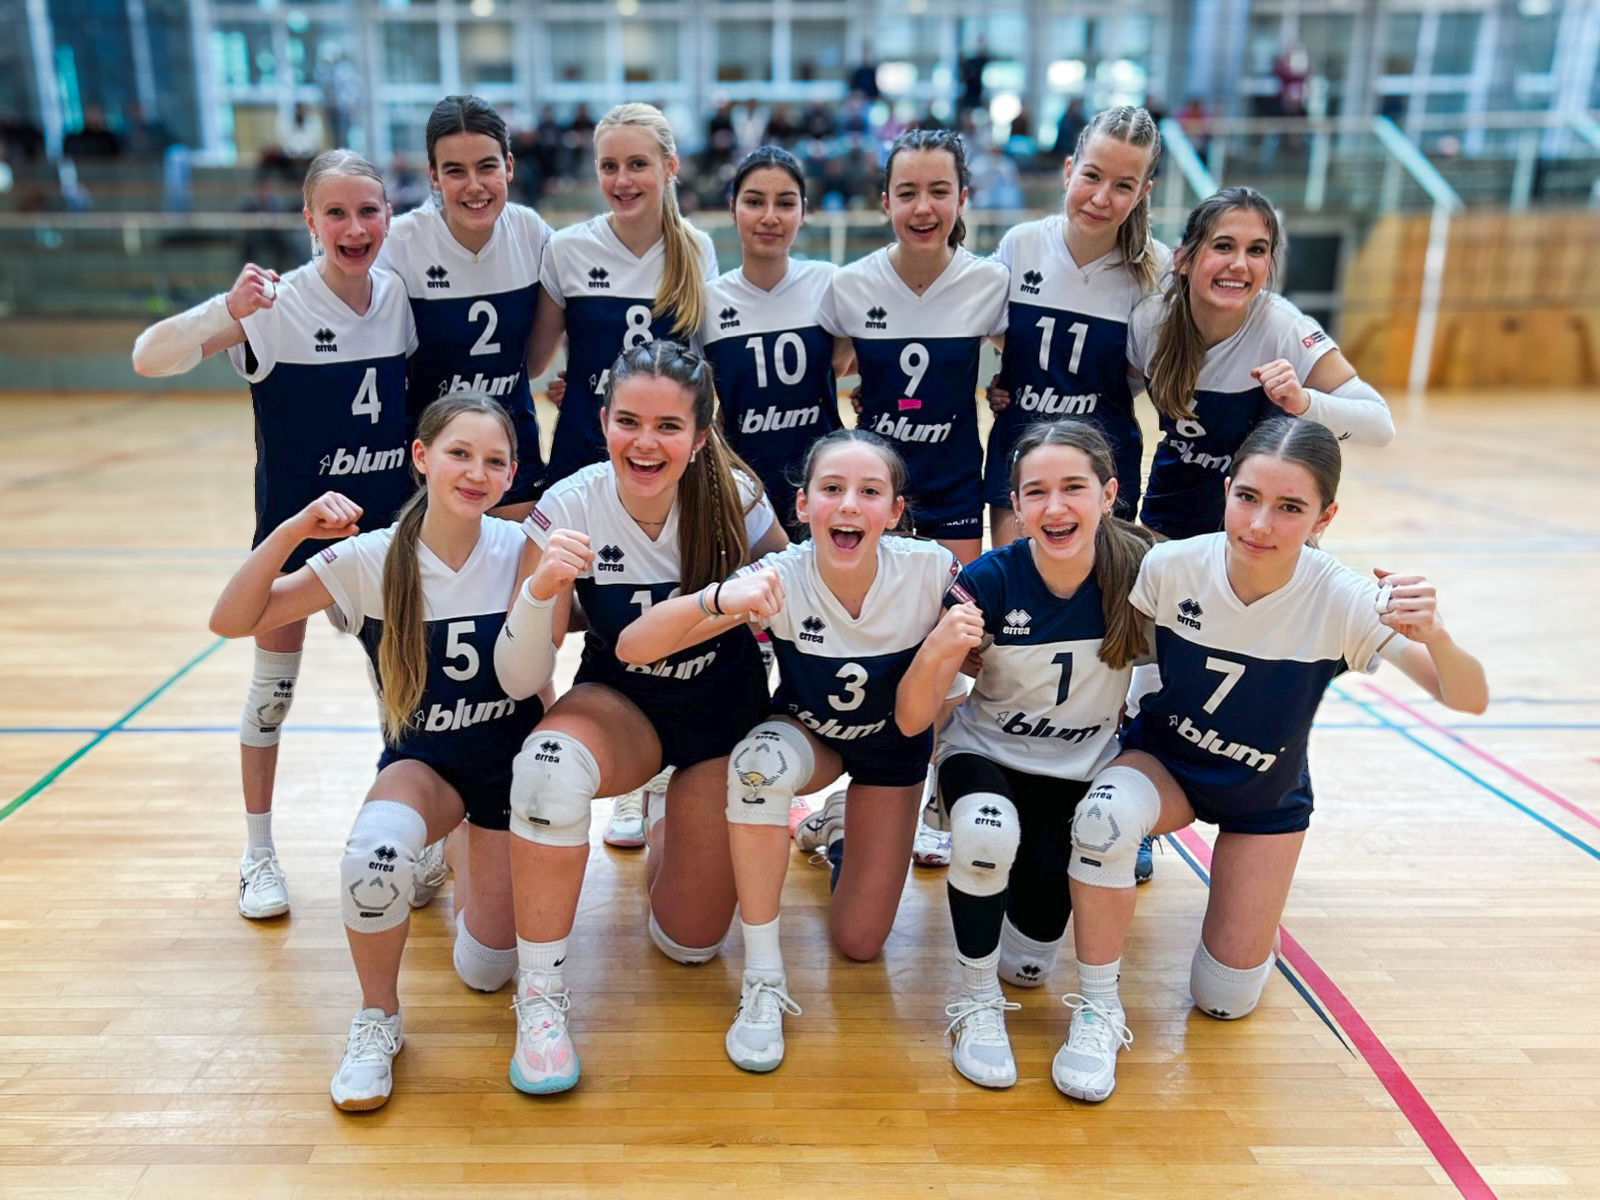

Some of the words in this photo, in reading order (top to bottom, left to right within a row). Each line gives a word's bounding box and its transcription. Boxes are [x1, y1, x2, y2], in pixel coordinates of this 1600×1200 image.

[468, 300, 501, 356] 2
[622, 305, 653, 350] 8
[1035, 316, 1089, 375] 11
[448, 371, 521, 396] blum
[745, 332, 807, 388] 10
[899, 342, 930, 398] 9
[351, 367, 382, 424] 4
[741, 405, 820, 434] blum
[1019, 384, 1098, 415] blum
[874, 412, 953, 444] blum
[329, 446, 405, 476] blum
[442, 620, 480, 682] 5
[827, 662, 869, 712] 3
[1050, 651, 1074, 707] 1
[1202, 655, 1247, 715] 7
[424, 696, 516, 732] blum
[797, 709, 887, 741] blum
[1002, 711, 1102, 745] blum
[1176, 716, 1277, 773] blum
